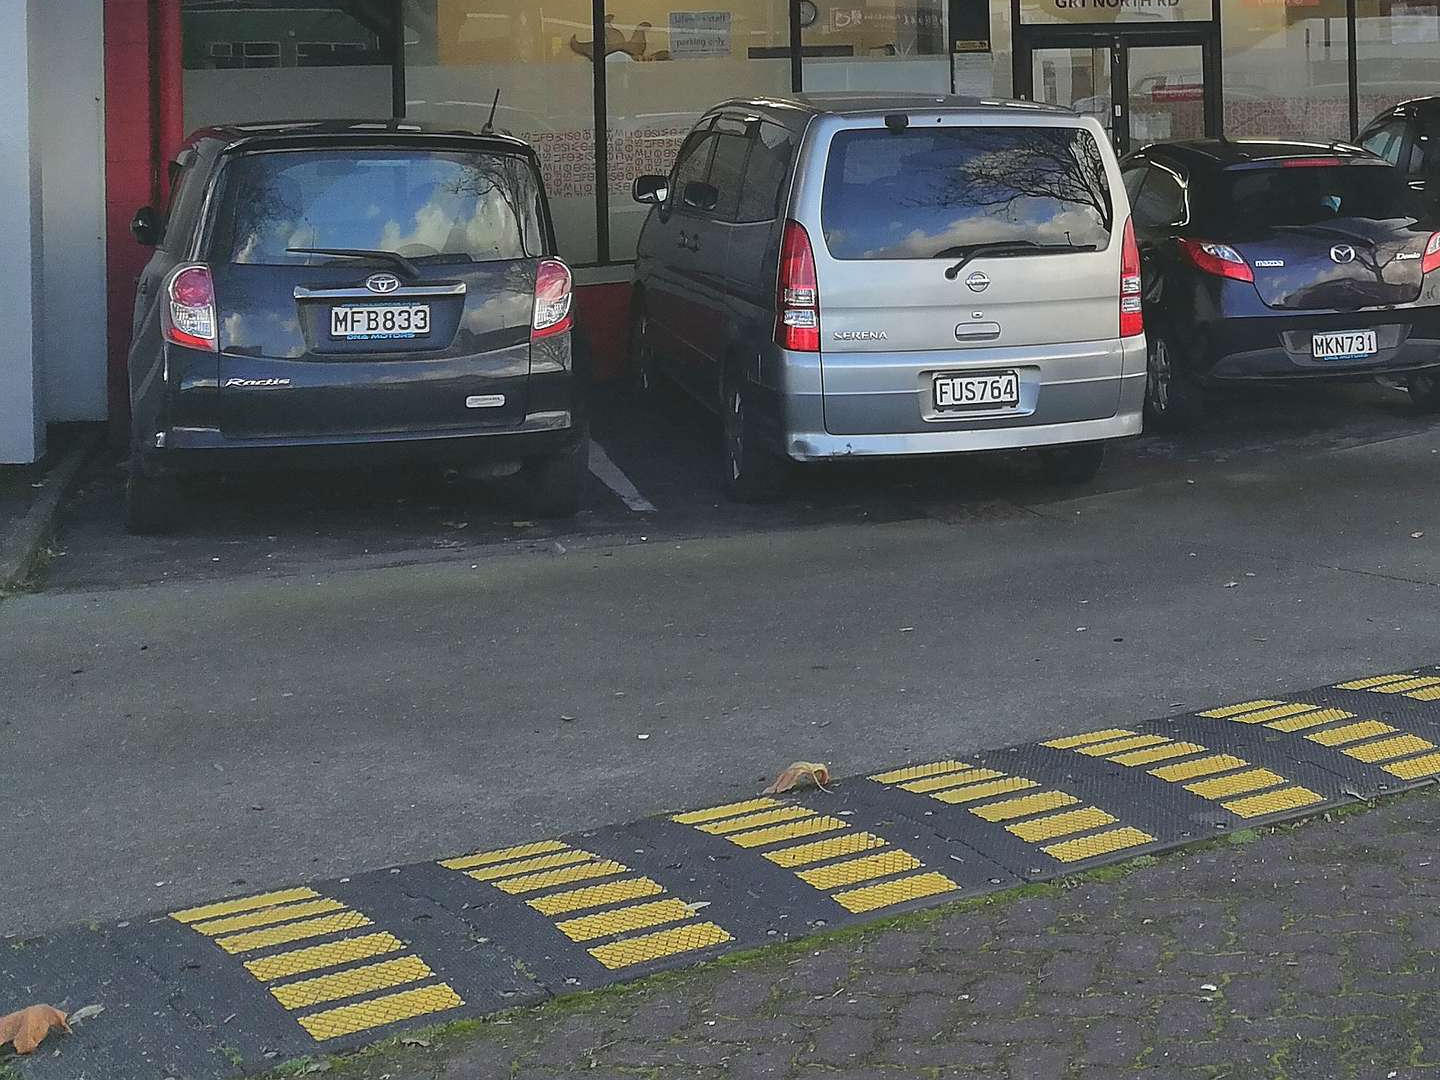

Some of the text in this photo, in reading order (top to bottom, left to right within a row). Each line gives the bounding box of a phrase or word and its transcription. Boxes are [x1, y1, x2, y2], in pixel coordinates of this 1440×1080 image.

[334, 309, 429, 333] MFB833
[832, 331, 888, 341] SERENA
[1314, 333, 1375, 355] MKN731
[938, 379, 1015, 404] FUS764
